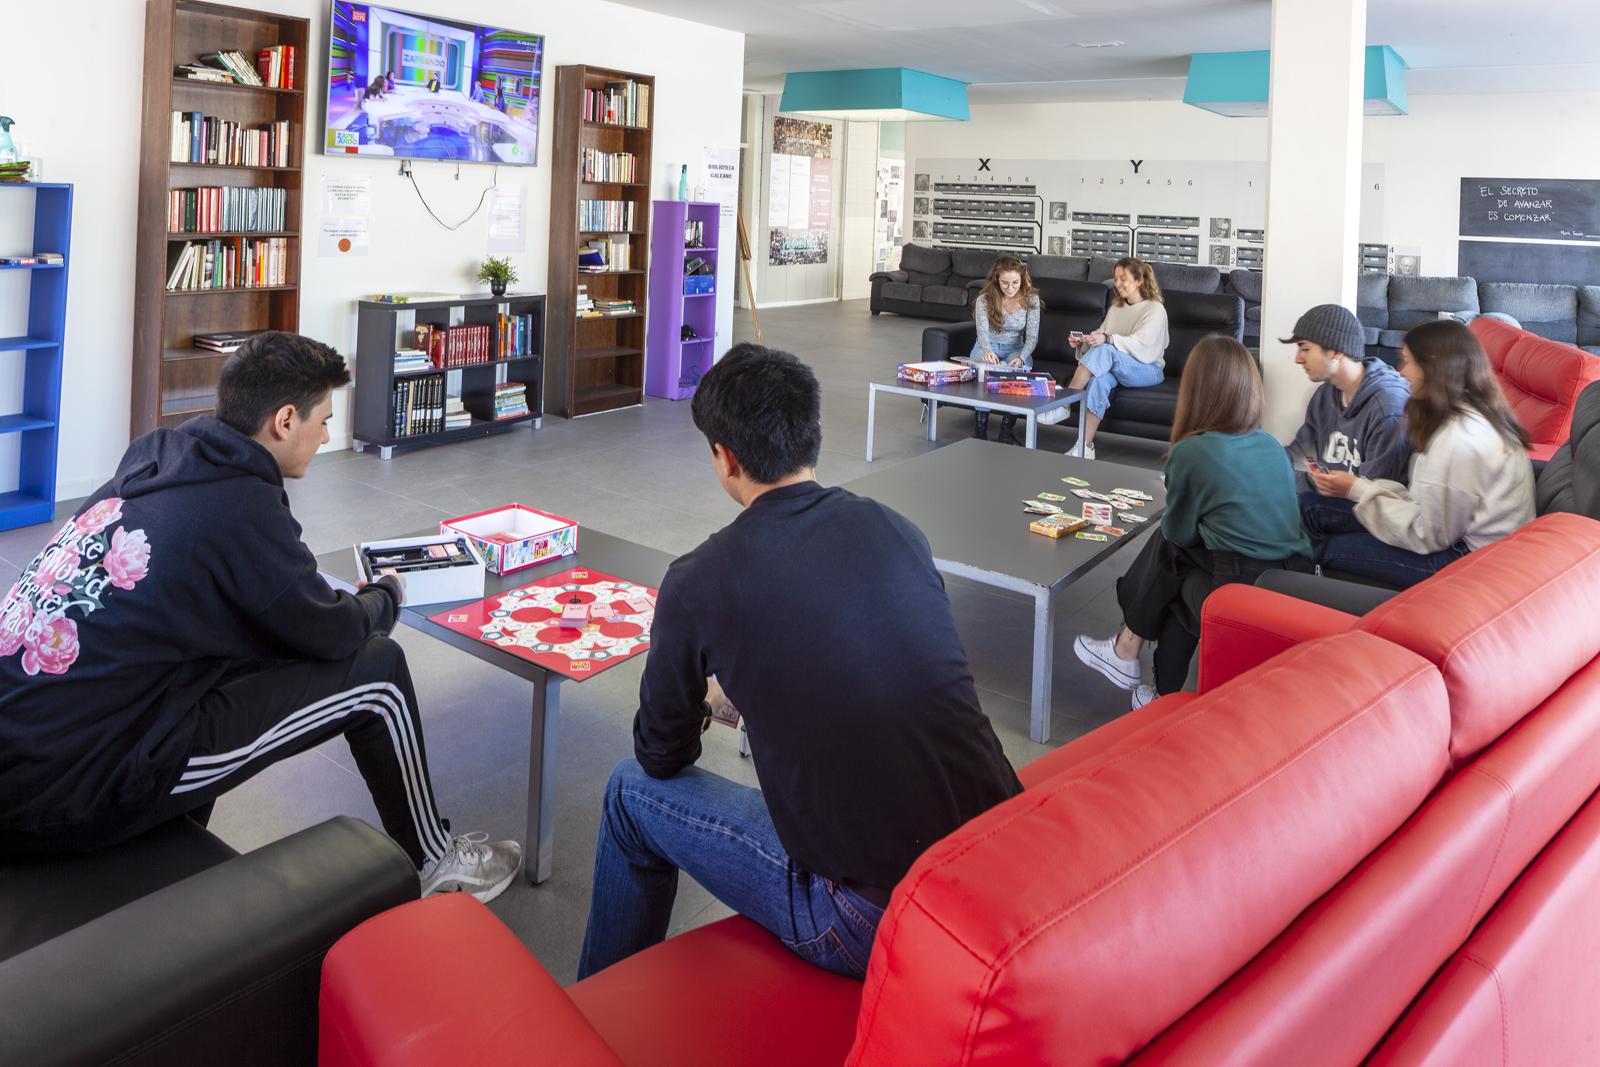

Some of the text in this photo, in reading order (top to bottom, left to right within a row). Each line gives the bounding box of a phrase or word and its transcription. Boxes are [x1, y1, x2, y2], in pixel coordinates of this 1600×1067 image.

[404, 54, 445, 68] ZAPEANDO
[978, 158, 991, 171] X
[1130, 160, 1144, 173] Y
[1500, 185, 1539, 197] SECRETO
[1497, 199, 1553, 209] DE AVANZAR
[1488, 211, 1499, 221] ES
[1231, 247, 1235, 255] 3
[54, 521, 104, 560] Make
[45, 546, 113, 600] World
